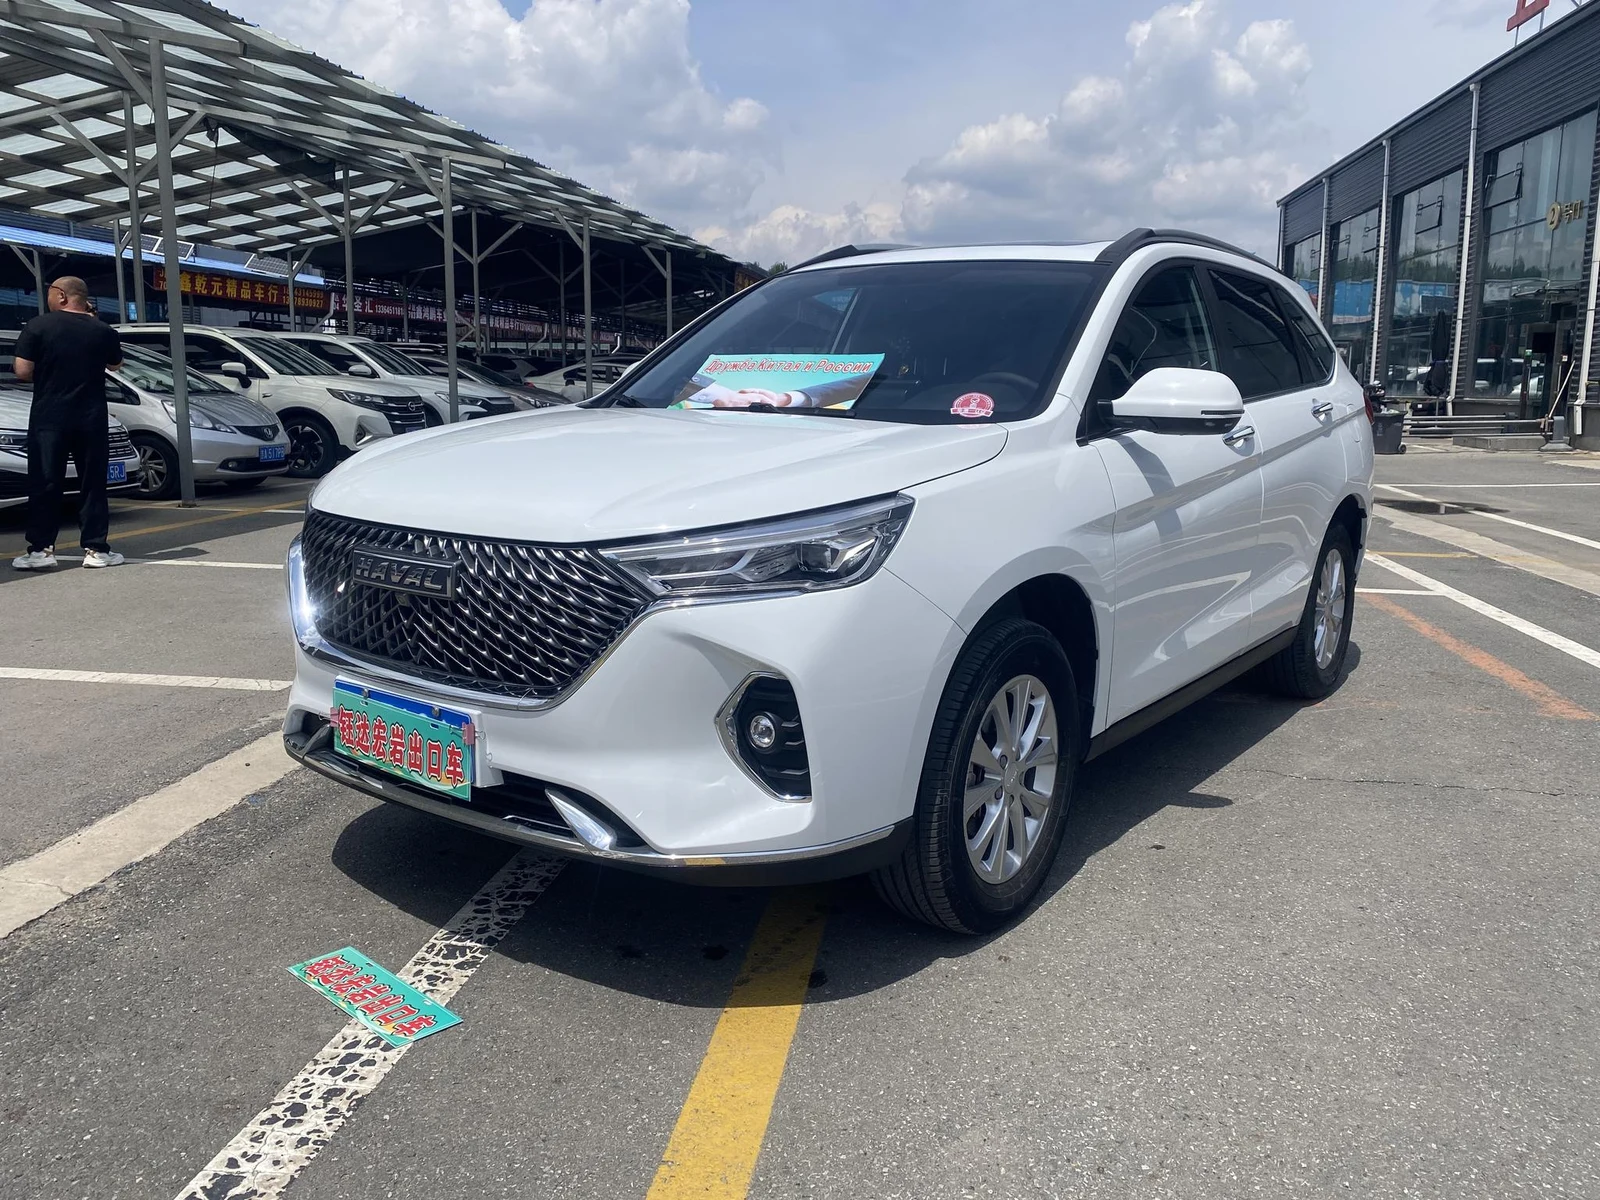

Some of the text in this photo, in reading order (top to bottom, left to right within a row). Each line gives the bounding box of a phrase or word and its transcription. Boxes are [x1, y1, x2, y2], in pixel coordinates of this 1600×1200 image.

[1548, 200, 1583, 228] 2号门
[179, 271, 279, 304] 鑫乾元精品车行
[282, 295, 324, 308] 1378930927
[374, 304, 404, 316] 1336451181
[704, 357, 874, 375] Дружба Китая и России
[355, 557, 442, 591] HAVAL
